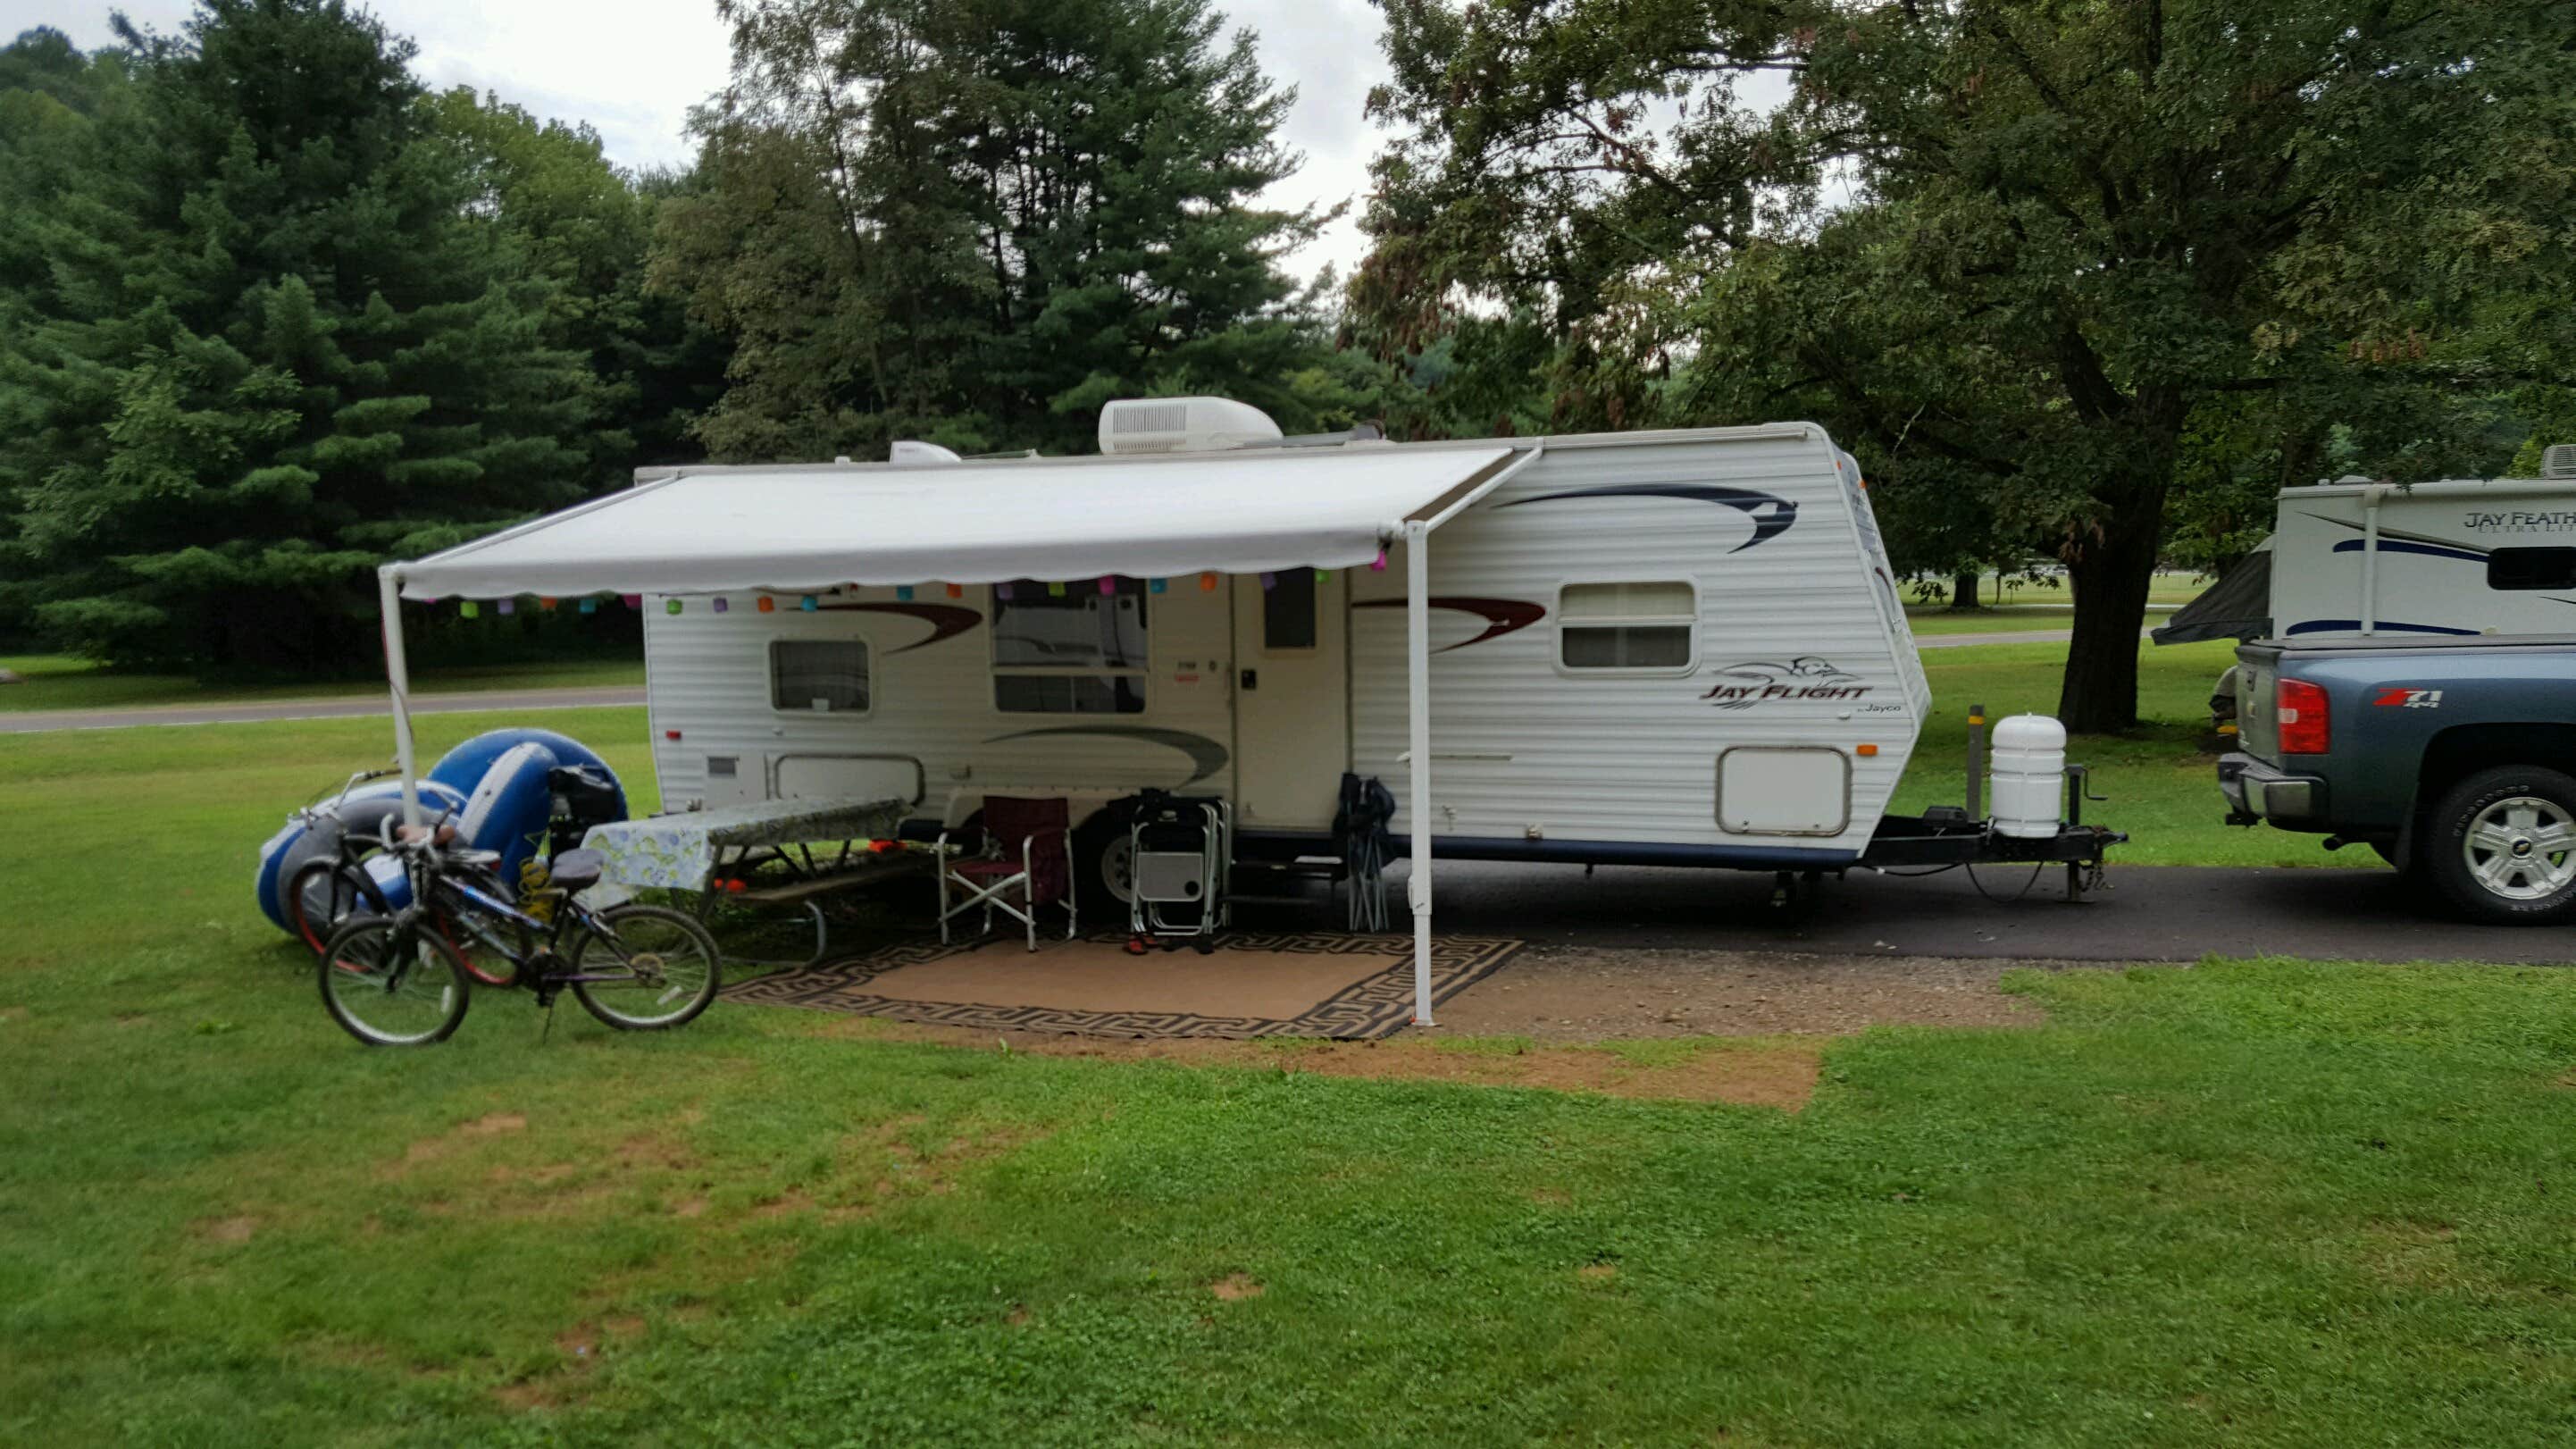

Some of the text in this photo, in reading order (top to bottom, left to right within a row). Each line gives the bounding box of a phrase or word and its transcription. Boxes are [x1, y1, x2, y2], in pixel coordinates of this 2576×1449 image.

[2463, 513, 2506, 528] JAY
[1699, 684, 1874, 700] JAY FLIGHT
[2372, 688, 2443, 706] Z71
[1865, 703, 1902, 714] Jayco
